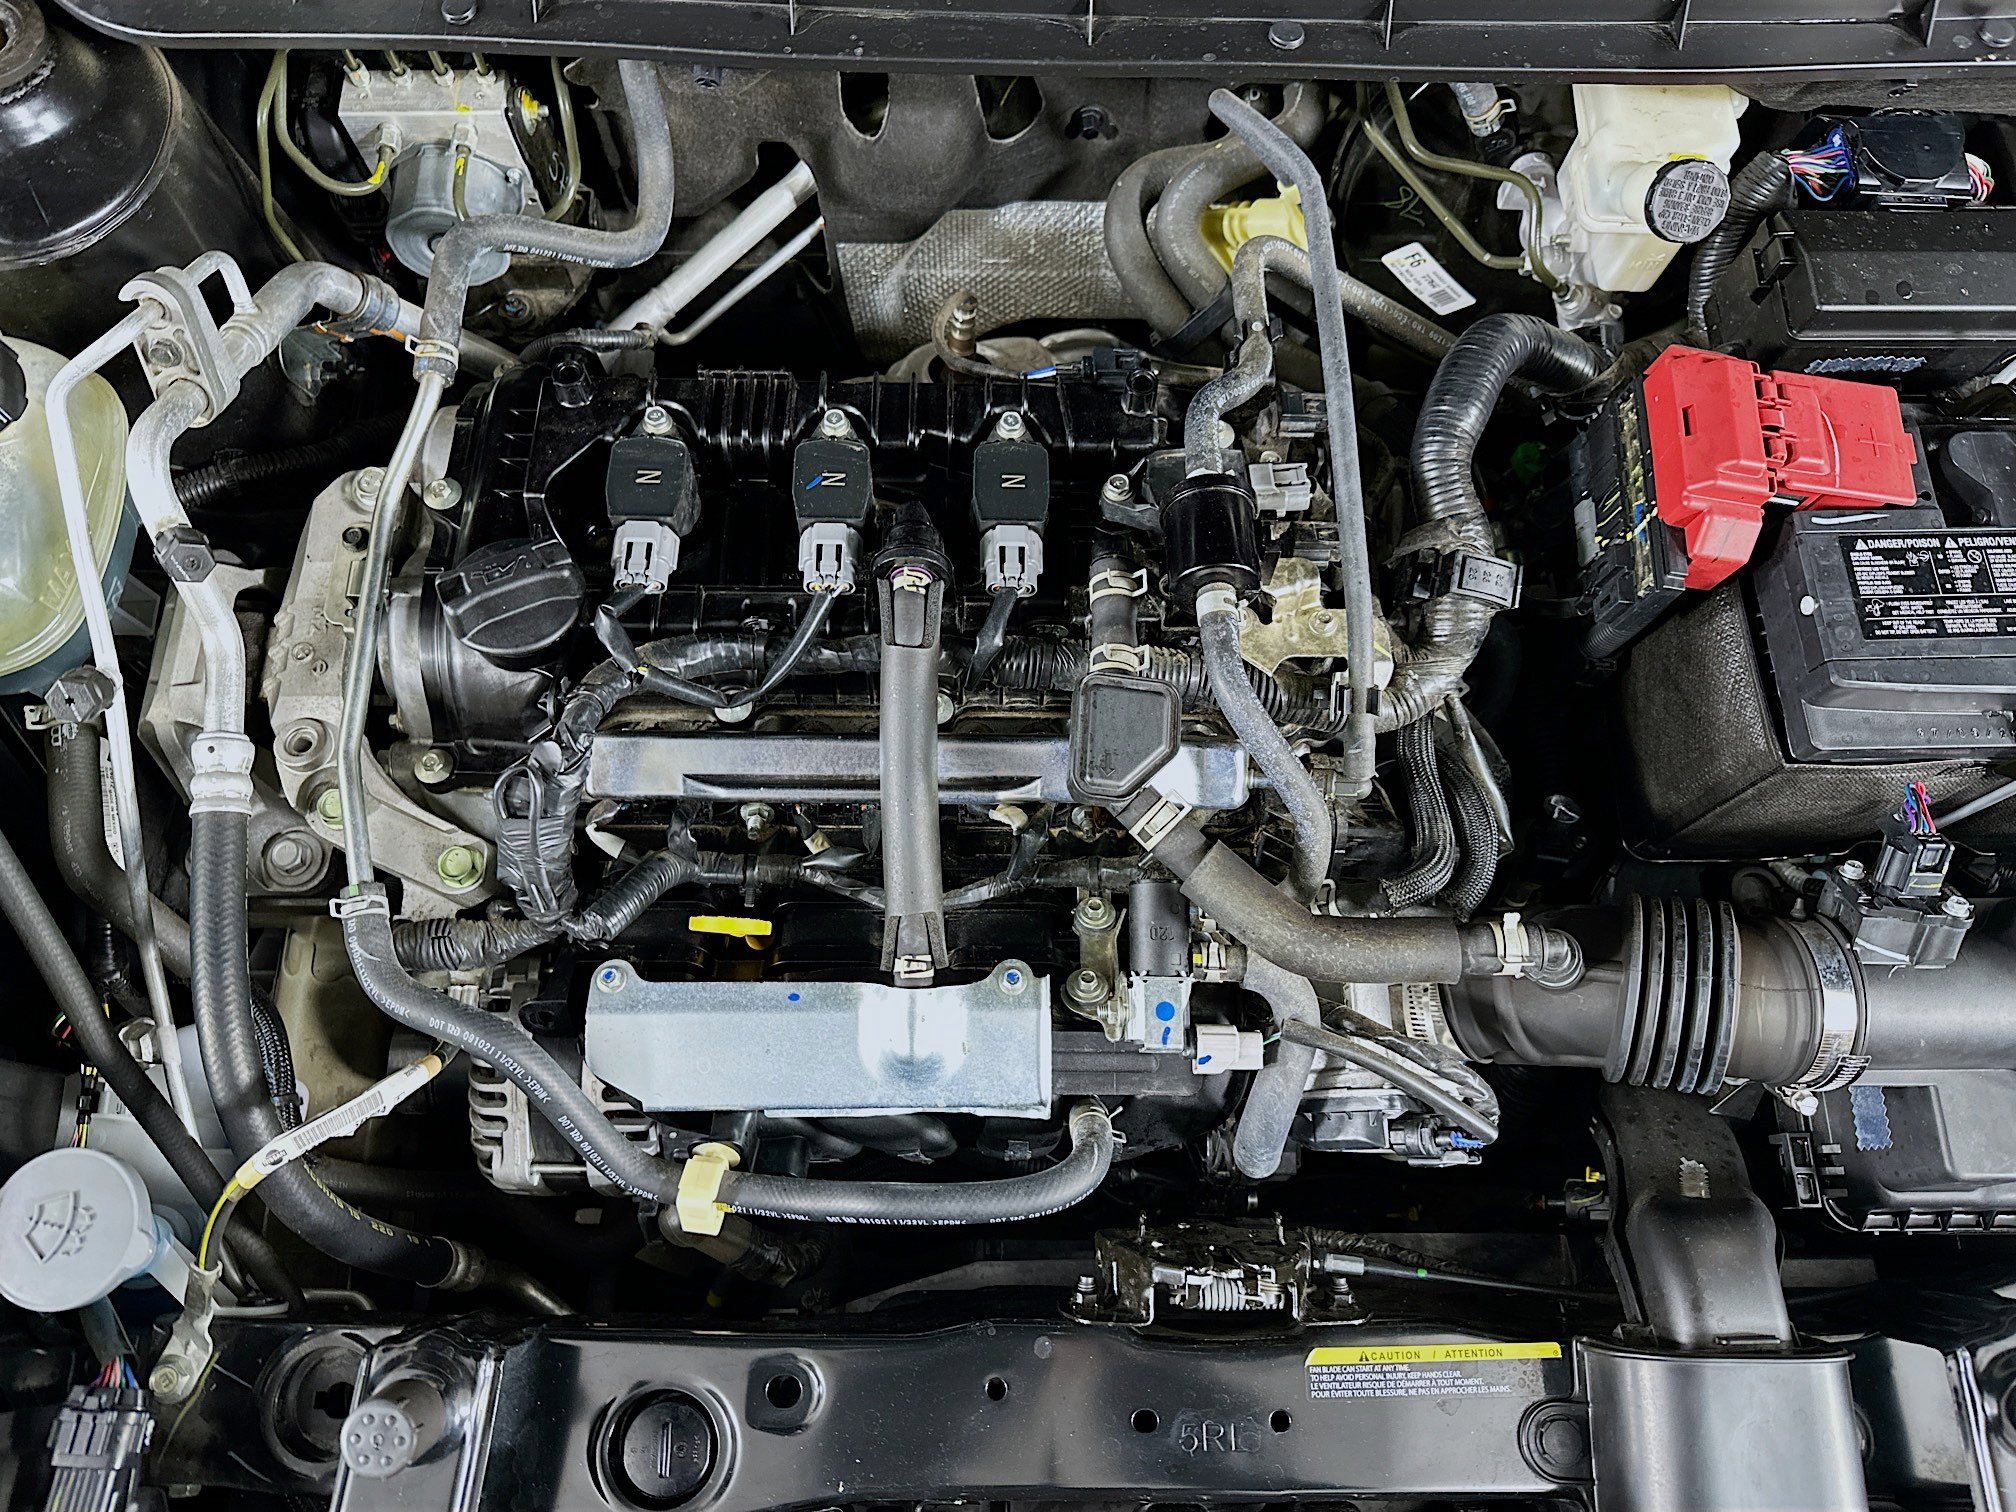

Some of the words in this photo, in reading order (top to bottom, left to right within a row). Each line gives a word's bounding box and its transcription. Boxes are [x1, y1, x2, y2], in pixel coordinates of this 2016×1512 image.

[1404, 252, 1427, 268] F6
[1867, 538, 1941, 549] DANGER/POISON
[429, 1017, 446, 1031] DOT
[463, 1031, 496, 1055] 091021
[558, 1115, 574, 1131] DOT
[579, 1141, 605, 1166] 091021
[1371, 1351, 1421, 1361] CAUTION
[1444, 1349, 1503, 1359] ATTENTION
[1309, 1366, 1321, 1374] FAN
[1322, 1365, 1342, 1373] BLADE
[1342, 1365, 1355, 1373] CAN
[1310, 1374, 1319, 1382] TO
[1320, 1374, 1335, 1382] HELP
[1336, 1373, 1354, 1381] AVOID
[1355, 1373, 1386, 1381] PERSONAL
[1407, 1372, 1421, 1380] KEEP
[1422, 1371, 1442, 1379] HANDS
[1442, 1370, 1462, 1378] CLEAR.
[1311, 1383, 1320, 1391] LE
[1320, 1382, 1361, 1390] VENTILATEUR
[1362, 1381, 1386, 1389] RISQUE
[1397, 1379, 1431, 1388] DÉMARRER
[1431, 1378, 1437, 1387] À
[1454, 1378, 1485, 1386] MOMENT.
[1331, 1389, 1353, 1398] ÉVITER
[1353, 1389, 1375, 1397] TOUTE
[1375, 1388, 1408, 1397] BLESSURE,
[1408, 1388, 1418, 1396] NE
[1431, 1387, 1440, 1395] EN
[1440, 1386, 1478, 1394] APPROCHER
[1490, 1385, 1512, 1393] MAINS.
